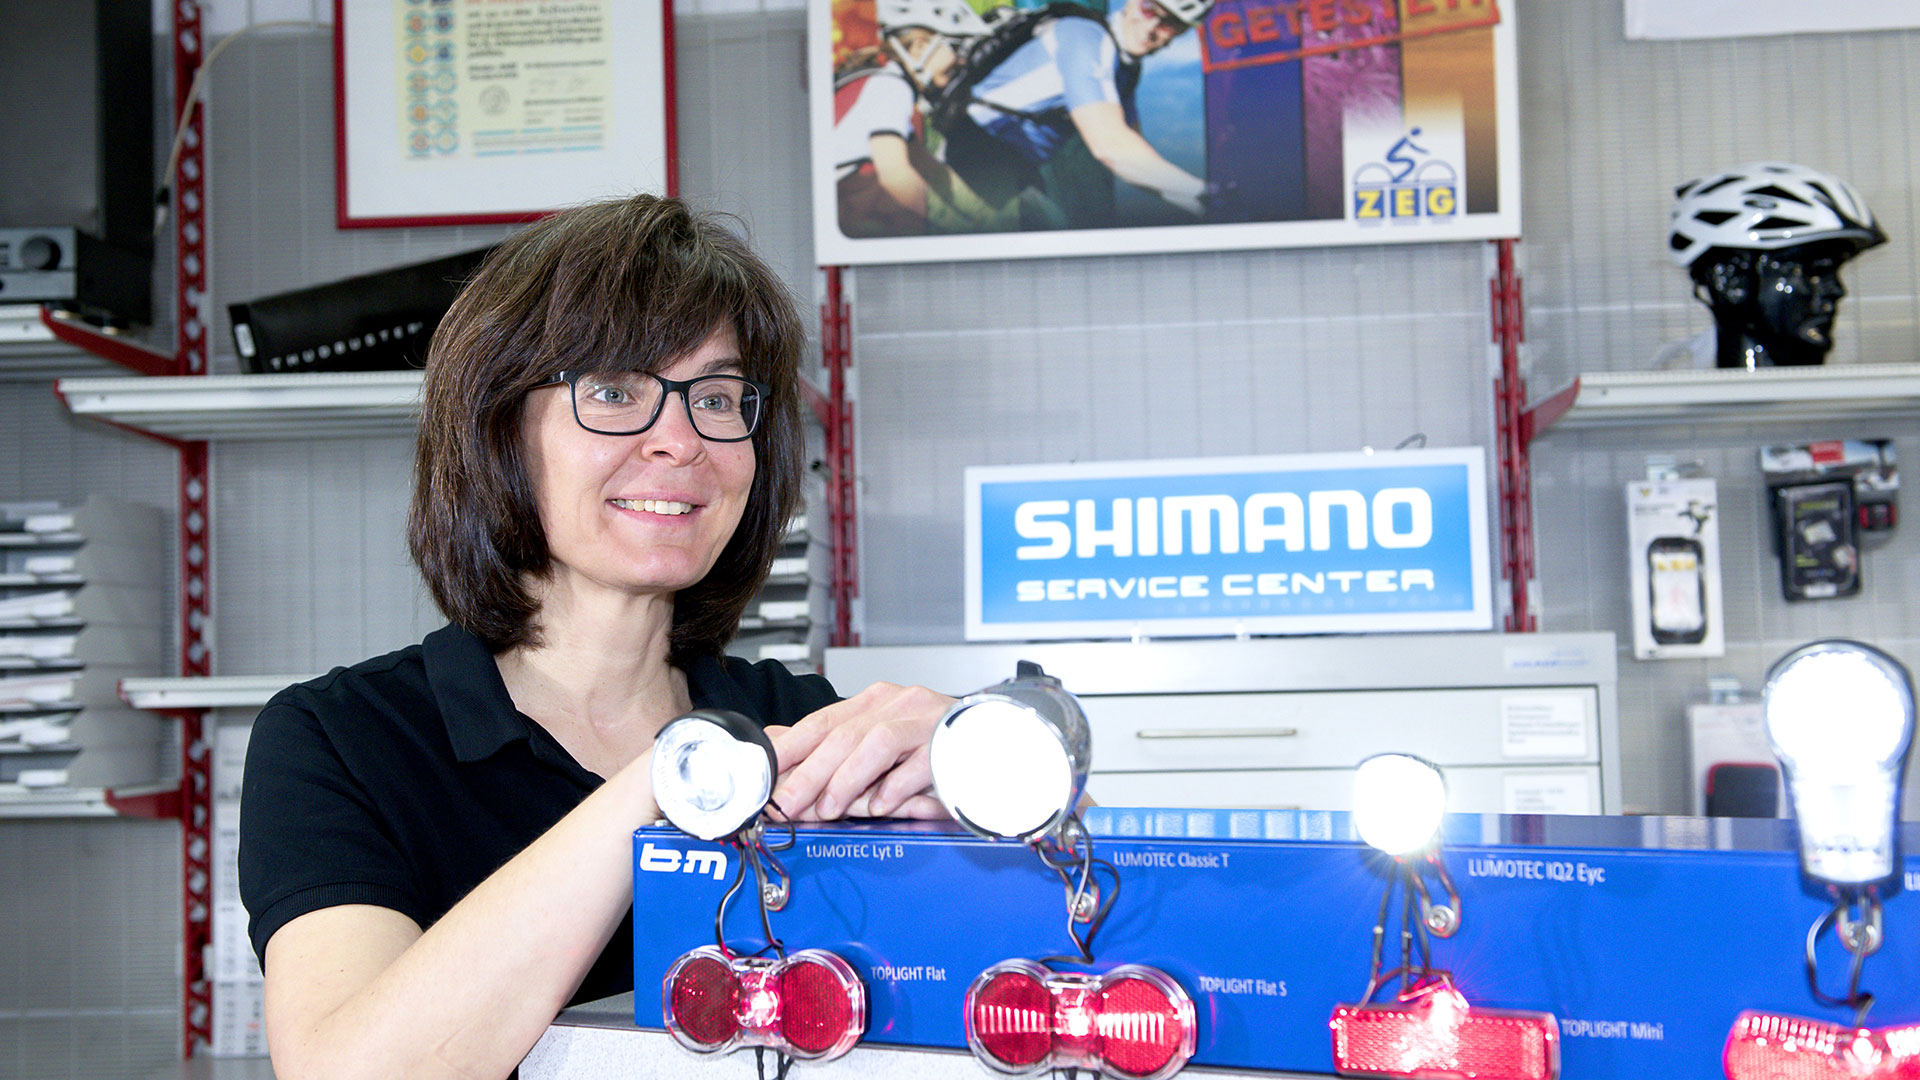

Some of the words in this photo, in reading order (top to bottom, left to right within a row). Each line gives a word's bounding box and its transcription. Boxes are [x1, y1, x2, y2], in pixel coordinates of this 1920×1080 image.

[1357, 187, 1455, 218] ZEG
[1015, 487, 1433, 560] SHIMANO
[1016, 575, 1209, 602] SERVICE
[1222, 569, 1434, 596] CENTER
[806, 844, 869, 858] LUMOTEC
[873, 844, 891, 861] Lyt
[895, 845, 904, 858] B
[1113, 851, 1176, 867] LUMOTEC
[1178, 852, 1219, 868] Classic
[1222, 853, 1230, 868] T
[1468, 858, 1544, 880] LUMOTEC
[1546, 861, 1575, 882] IQ2
[1577, 863, 1606, 886] Eyc
[871, 966, 923, 980] TOPLIGHT
[926, 966, 946, 981] Flat
[1199, 975, 1254, 994] TOPLIGHT
[1256, 979, 1277, 996] Flat
[1279, 980, 1288, 997] S
[1560, 1018, 1628, 1038] TOPLIGHT
[1630, 1021, 1664, 1040] Mini
